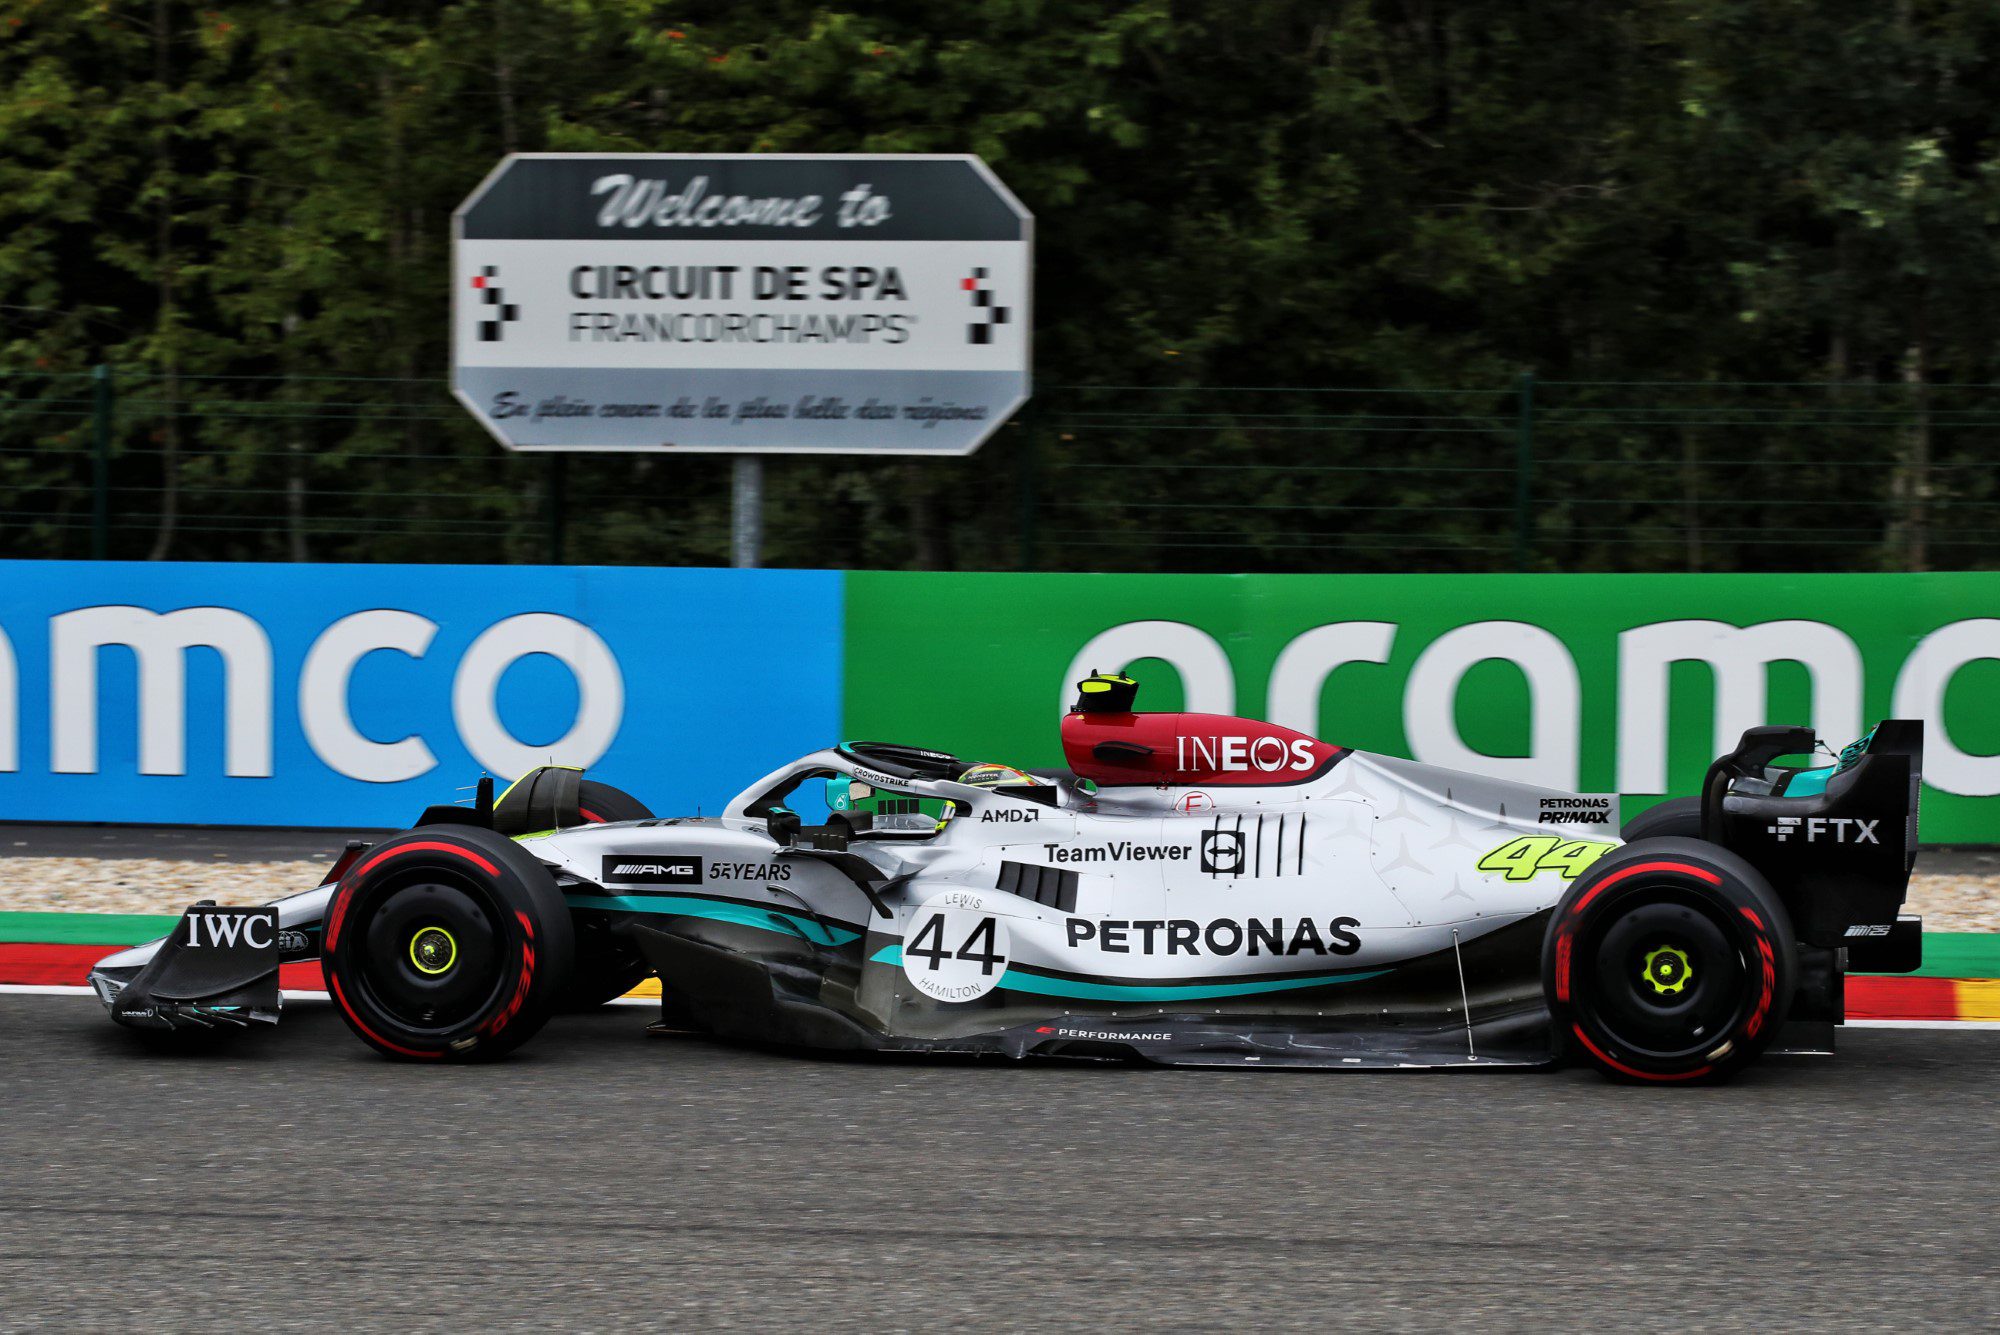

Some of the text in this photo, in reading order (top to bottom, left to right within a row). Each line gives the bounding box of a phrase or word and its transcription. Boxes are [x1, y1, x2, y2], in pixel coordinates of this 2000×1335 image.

[591, 174, 892, 228] Welcome to
[569, 266, 908, 301] CIRCUIT DE SPA
[568, 312, 911, 344] FRANCORCHAMPS
[0, 604, 625, 784] mco
[1176, 735, 1316, 772] INEOS
[853, 767, 910, 787] CROWDSTRIKE
[981, 808, 1023, 823] AMD
[1538, 809, 1613, 824] PRIMAX
[1540, 798, 1609, 809] PETRONAS
[1807, 817, 1880, 845] FTX
[1044, 841, 1192, 863] TeamViewer
[1477, 835, 1618, 882] 44
[637, 864, 694, 876] AMG
[944, 893, 983, 910] LEWIS
[186, 913, 274, 949] IWC
[906, 913, 1006, 976] 44
[1065, 915, 1362, 957] PETRONAS
[918, 977, 982, 999] HAMILTON
[1058, 1028, 1173, 1041] PERFORMANCE
